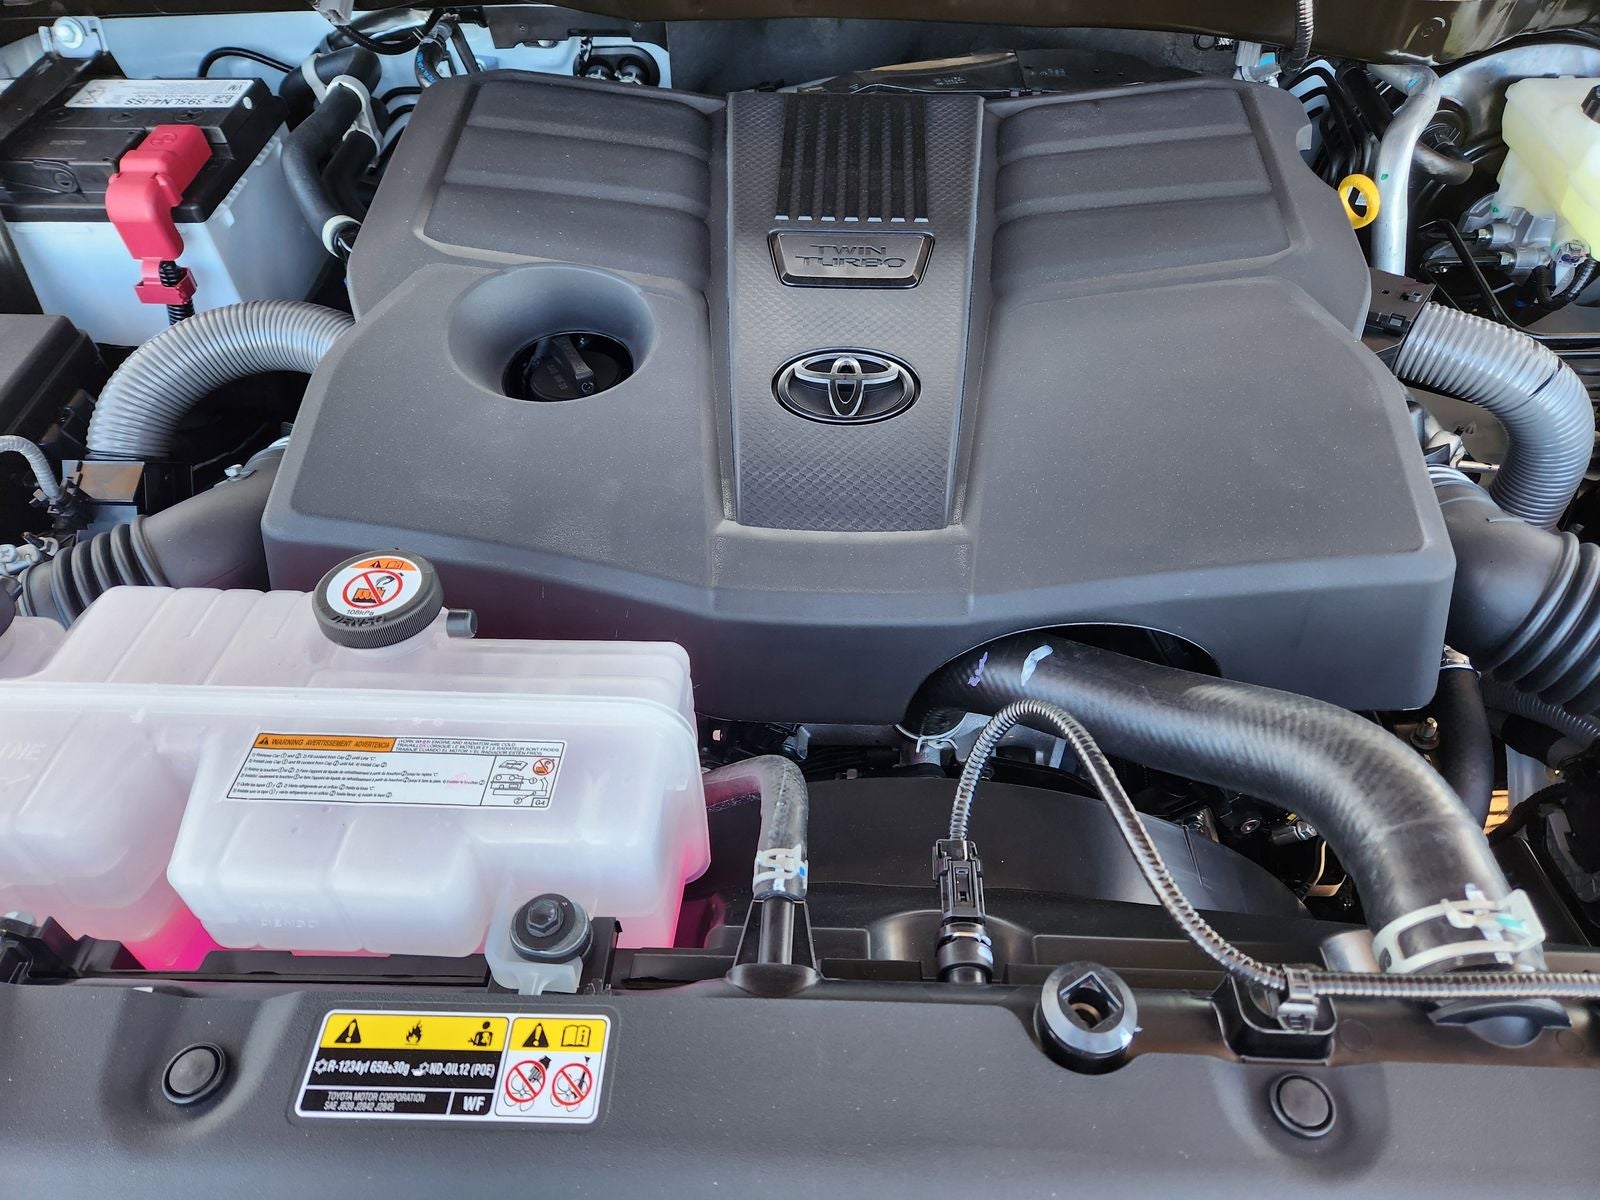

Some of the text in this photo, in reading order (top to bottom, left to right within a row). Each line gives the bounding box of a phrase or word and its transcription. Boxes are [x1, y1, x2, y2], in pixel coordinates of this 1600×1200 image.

[810, 244, 886, 256] TWIN
[795, 255, 907, 268] TURBO
[271, 738, 390, 749] WARNING AVERTISSEMENT ADVERTENCIA
[327, 1059, 370, 1076] R-1234yf
[470, 1062, 496, 1079] (POE)
[327, 1091, 427, 1103] TOYOTA MOTOR CORPORATION
[324, 1101, 338, 1111] SAE
[463, 1096, 486, 1112] WF
